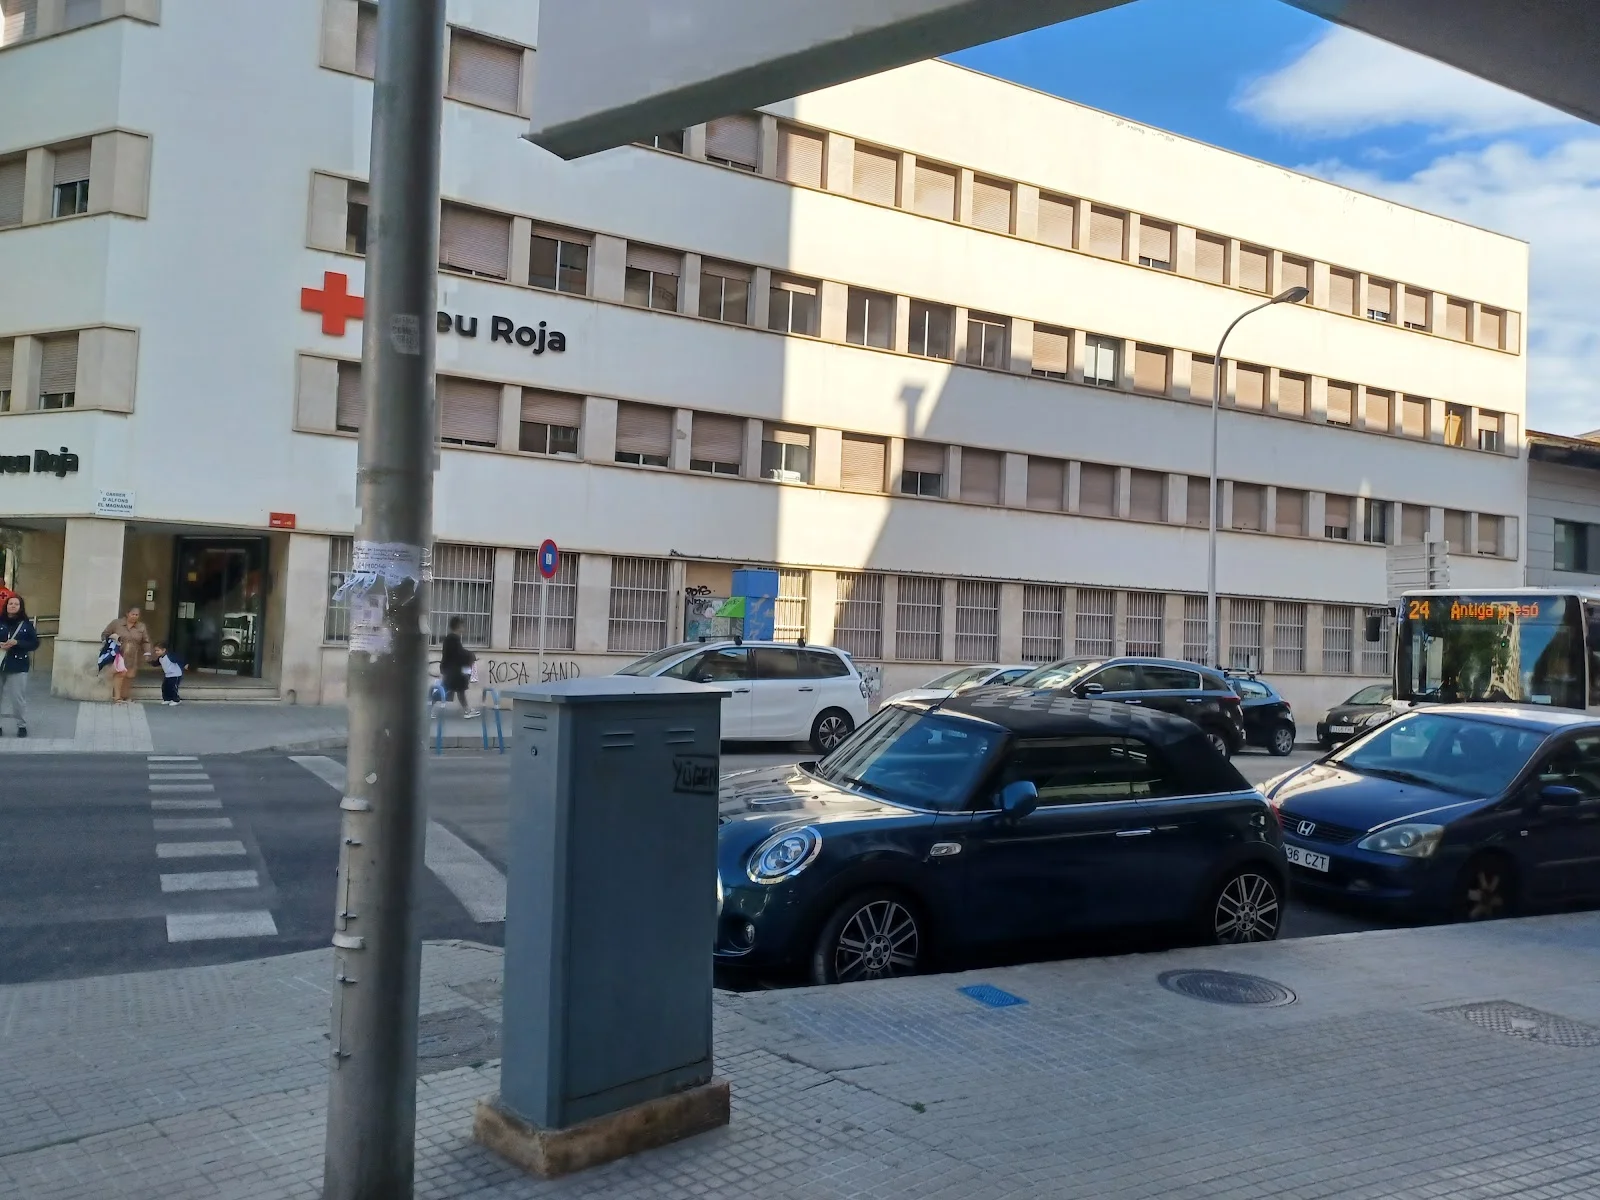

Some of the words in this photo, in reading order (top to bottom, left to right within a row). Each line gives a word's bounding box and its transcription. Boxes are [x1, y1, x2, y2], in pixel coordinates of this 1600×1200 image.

[437, 311, 478, 337] eu
[491, 315, 567, 355] Roja
[1409, 600, 1430, 620] 24
[1451, 601, 1494, 620] Antiga
[1498, 602, 1539, 620] presó
[488, 660, 529, 685] ROSA
[1287, 847, 1300, 862] 36
[1305, 852, 1327, 869] CZT
